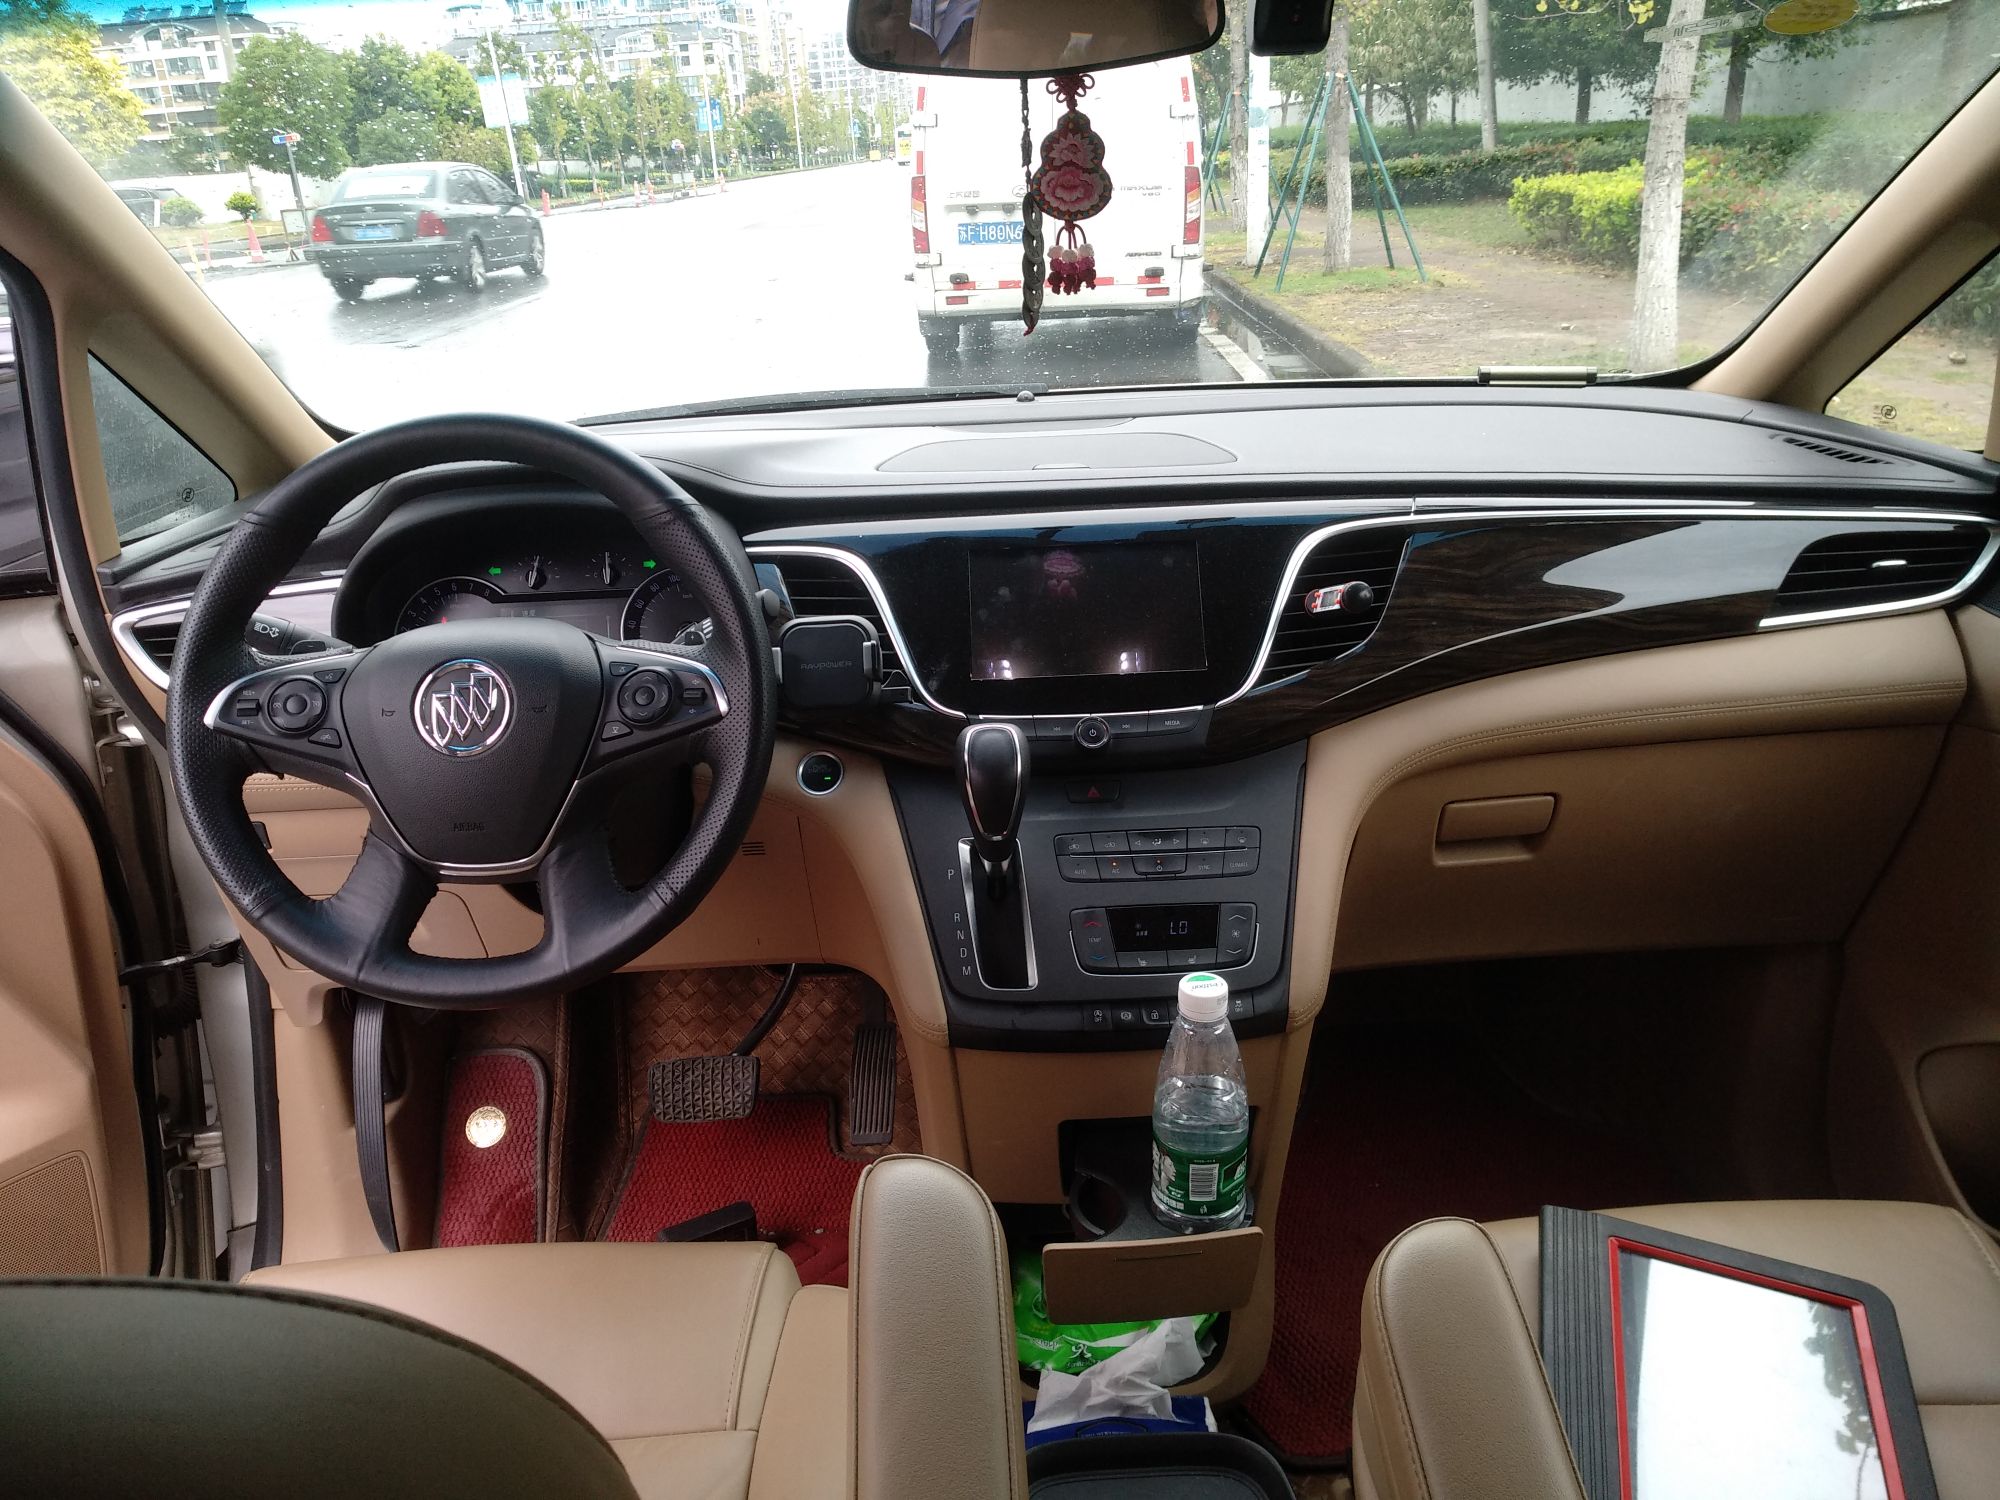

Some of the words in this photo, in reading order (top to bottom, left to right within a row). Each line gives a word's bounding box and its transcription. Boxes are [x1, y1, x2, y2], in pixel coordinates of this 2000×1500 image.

[947, 868, 955, 881] P
[953, 911, 961, 923] R
[957, 929, 965, 941] N
[960, 947, 968, 959] D
[962, 965, 972, 976] M
